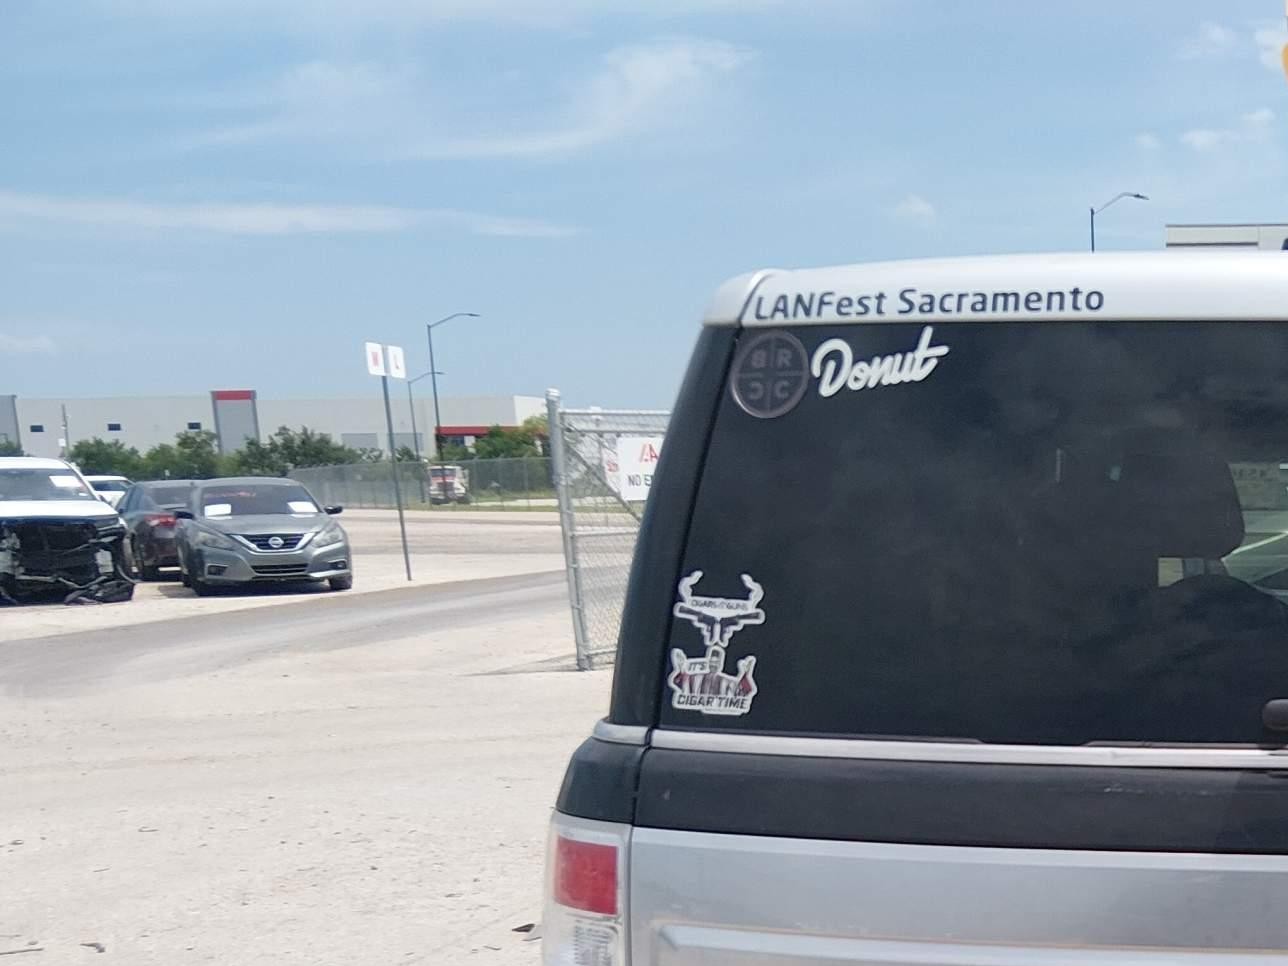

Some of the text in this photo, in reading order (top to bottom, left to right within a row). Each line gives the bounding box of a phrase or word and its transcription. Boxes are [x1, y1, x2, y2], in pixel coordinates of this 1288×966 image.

[755, 286, 1105, 320] LANFest Sacramento
[811, 325, 950, 397] Donut
[677, 694, 748, 710] CIGAR TIME
